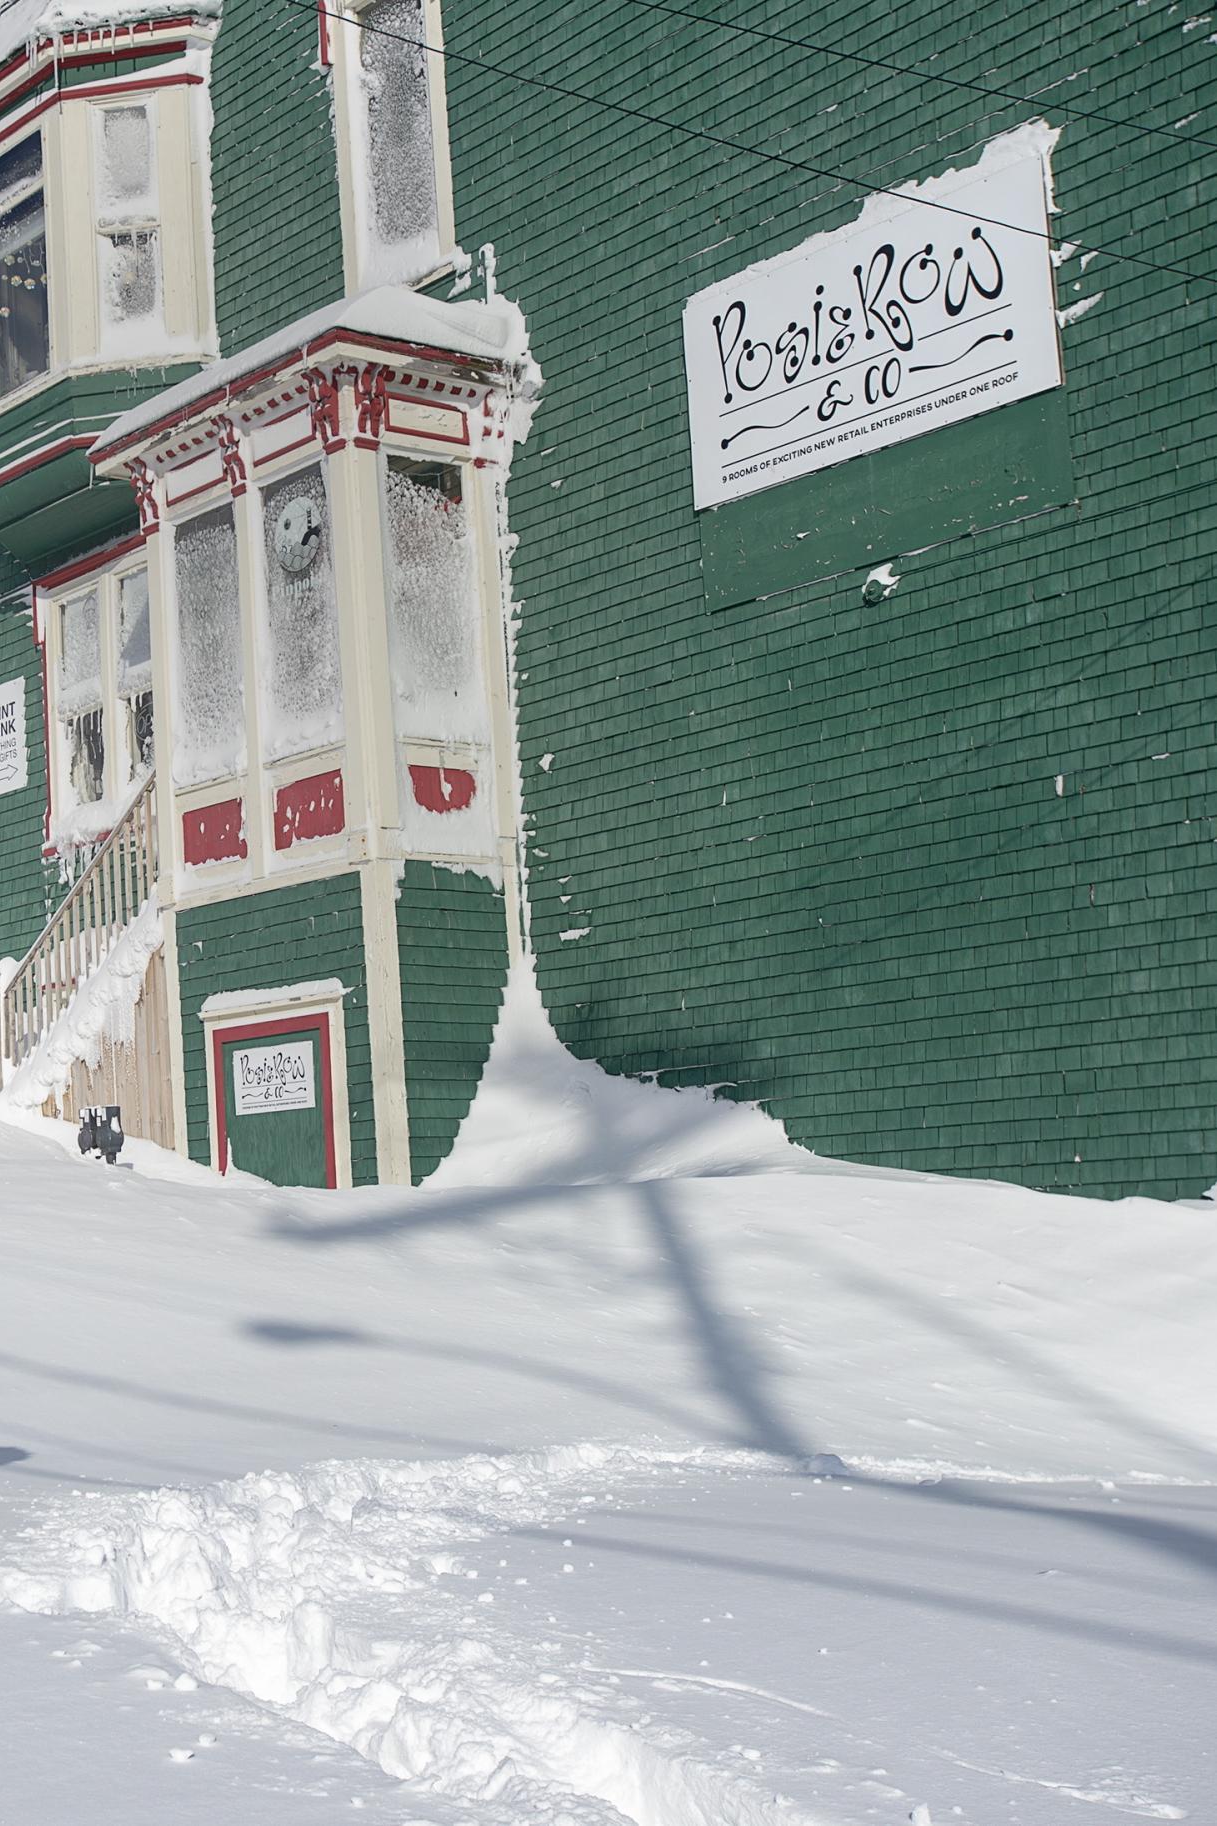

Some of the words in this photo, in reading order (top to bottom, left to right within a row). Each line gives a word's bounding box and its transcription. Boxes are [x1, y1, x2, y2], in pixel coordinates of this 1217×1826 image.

[721, 475, 728, 484] 9
[728, 464, 759, 481] ROOMS
[759, 461, 772, 470] OF
[772, 445, 814, 466] EXCITING
[813, 437, 836, 450] NEW
[837, 427, 869, 443] RETAIL
[870, 402, 933, 431] ENTERPRISES
[934, 390, 967, 409] UNDER
[969, 381, 990, 396] ONE
[991, 371, 1019, 388] ROOF
[817, 379, 854, 421] &
